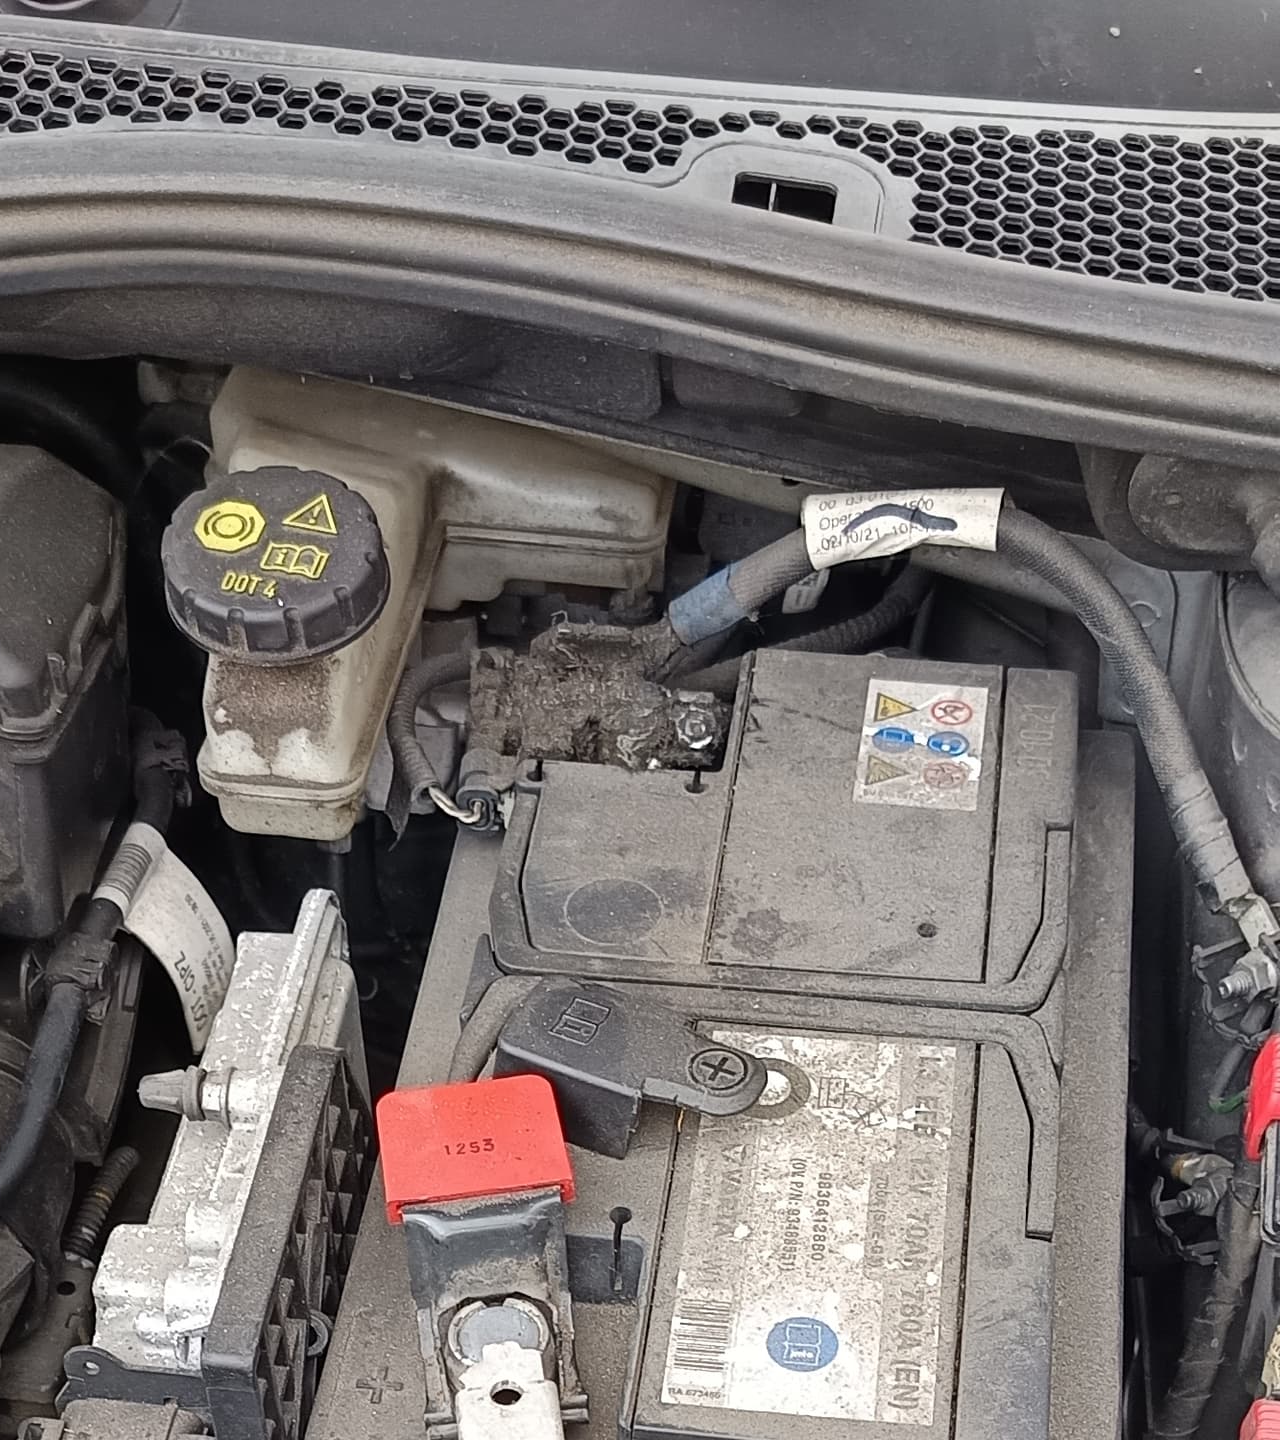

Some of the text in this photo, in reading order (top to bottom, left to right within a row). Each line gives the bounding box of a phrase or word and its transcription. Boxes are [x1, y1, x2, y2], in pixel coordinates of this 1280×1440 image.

[221, 571, 277, 599] DOT 4
[444, 1138, 495, 1155] 1253
[889, 1358, 923, 1409] (EN)
